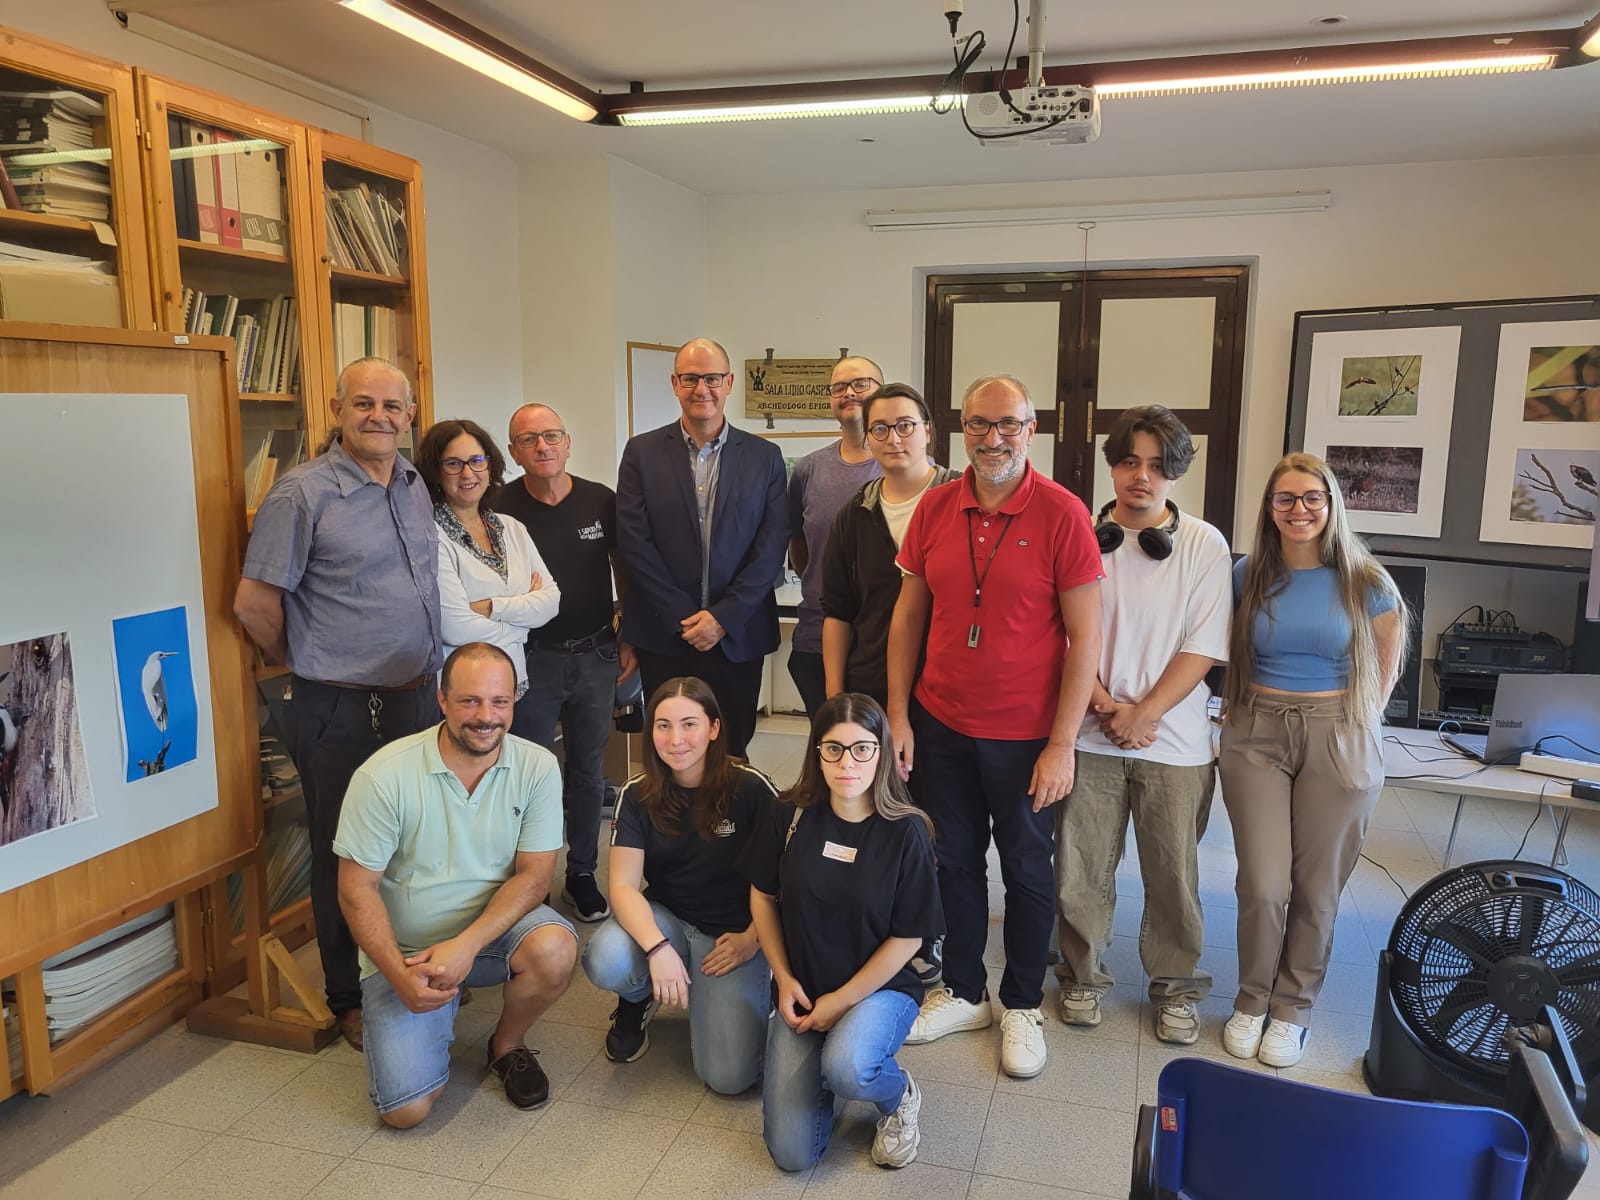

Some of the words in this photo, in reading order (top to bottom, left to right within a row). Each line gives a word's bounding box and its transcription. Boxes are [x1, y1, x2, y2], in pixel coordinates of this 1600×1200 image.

[764, 384, 783, 395] SALA
[785, 384, 805, 396] LIDIO
[806, 384, 831, 396] GASPE
[757, 402, 807, 410] ARCHEOLOGO
[809, 402, 831, 410] EPIGR
